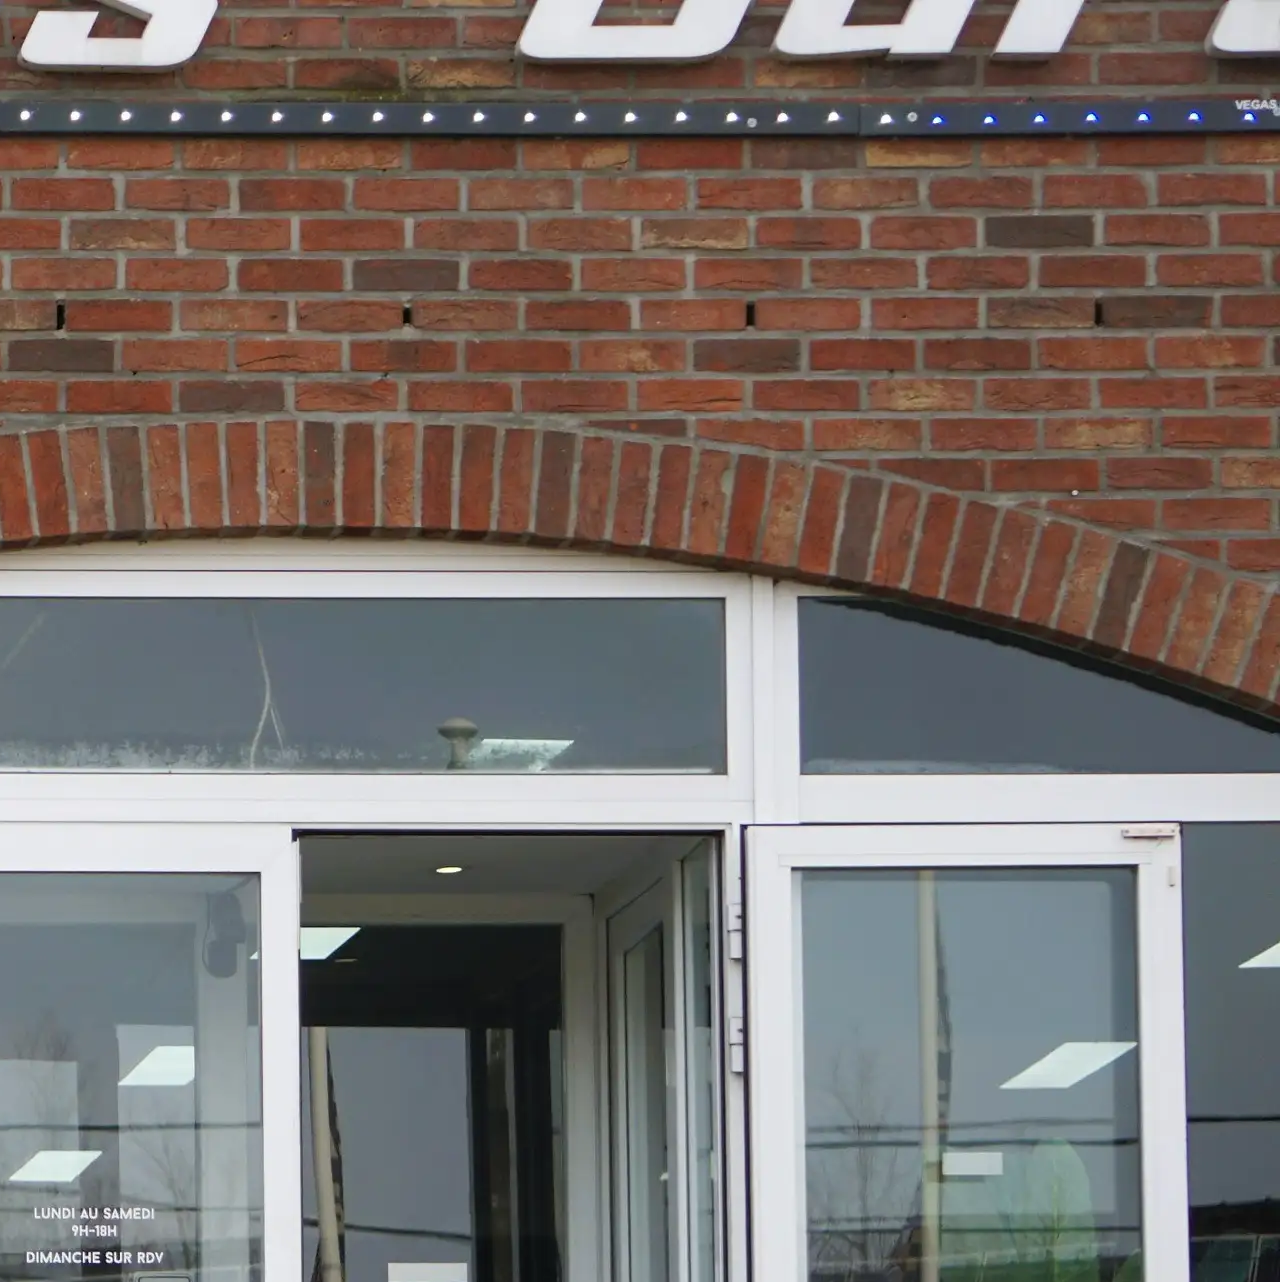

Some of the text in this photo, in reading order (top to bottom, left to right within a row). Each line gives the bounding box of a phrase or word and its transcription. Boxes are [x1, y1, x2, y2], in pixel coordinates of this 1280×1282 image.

[1234, 99, 1277, 110] VEGAS
[33, 1207, 155, 1220] LUNDI AU SAMEDI
[71, 1224, 117, 1237] 9H-18H
[26, 1251, 164, 1264] DIMANCHE SUR RDV
